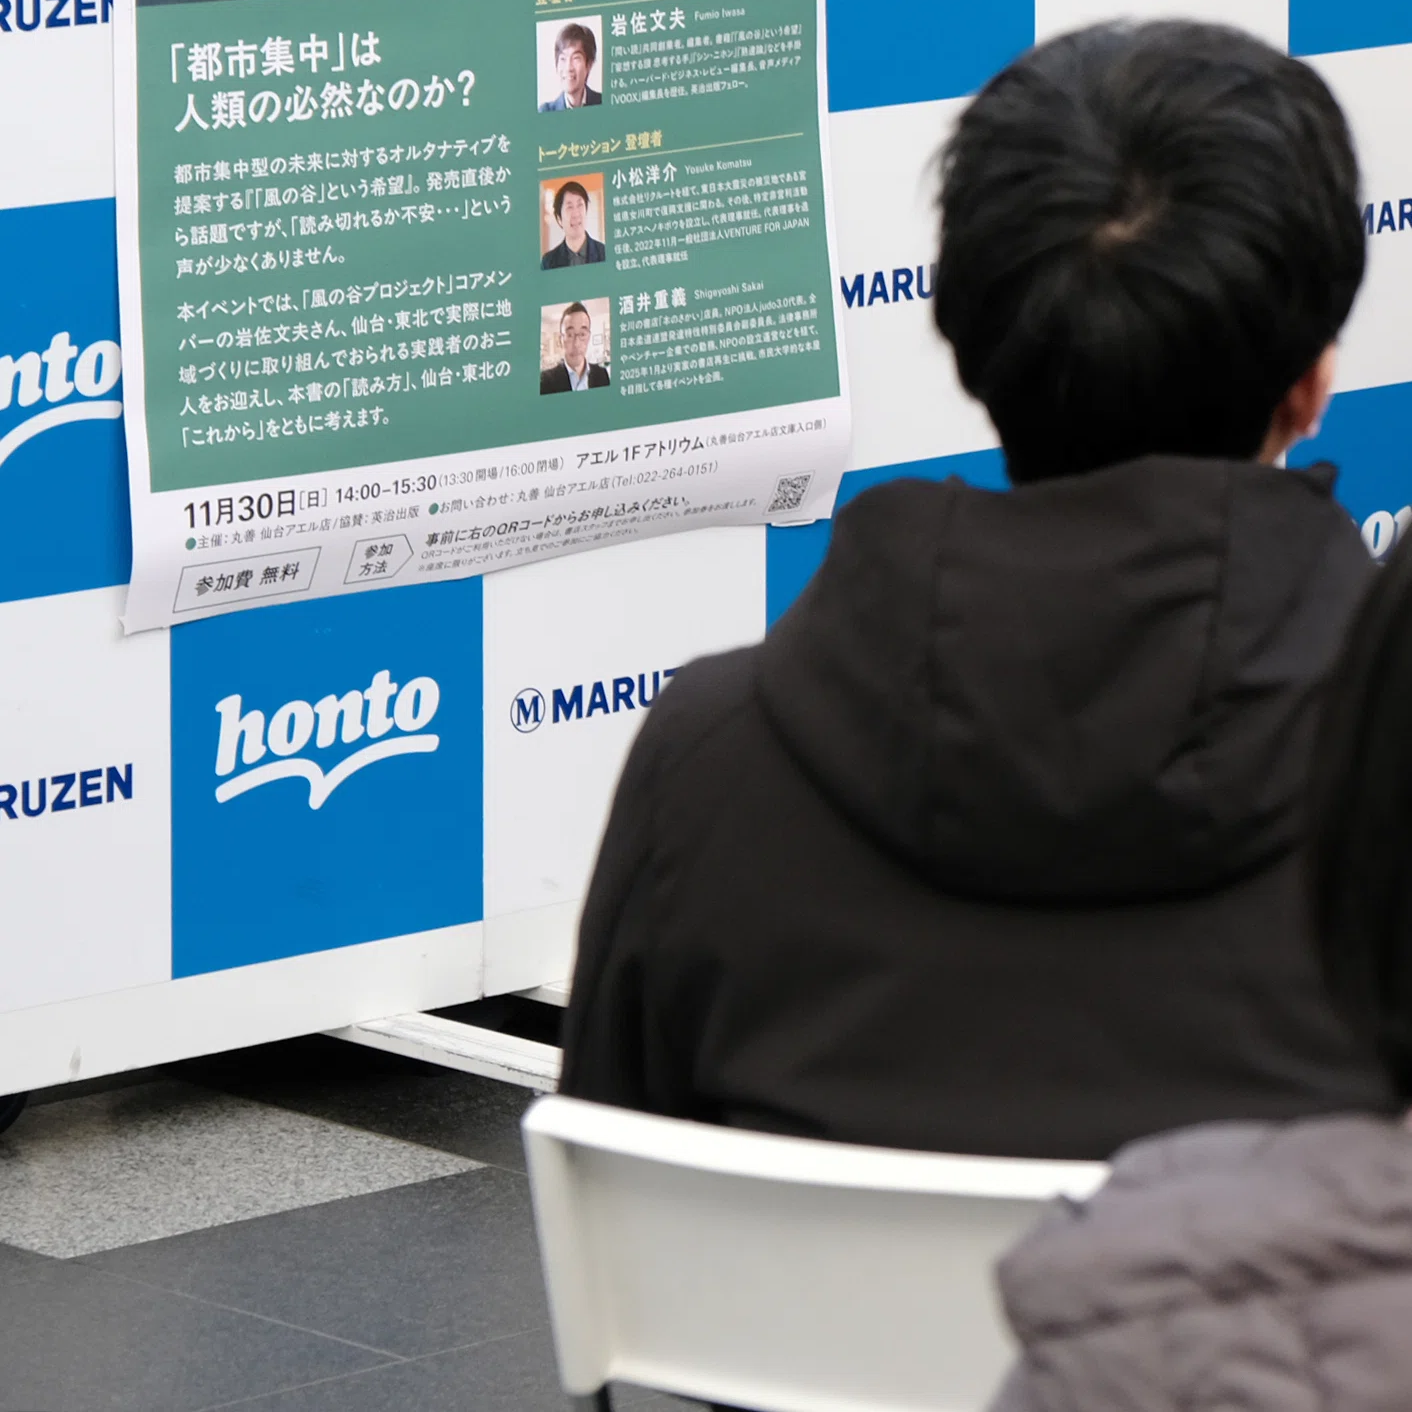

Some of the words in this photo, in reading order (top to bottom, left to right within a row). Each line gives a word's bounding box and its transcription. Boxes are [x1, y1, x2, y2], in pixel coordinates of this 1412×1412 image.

[611, 7, 686, 37] 岩佐文夫
[694, 10, 720, 22] Fumio
[721, 8, 746, 19] Iwasa
[171, 31, 382, 84] 「都市集中」は
[174, 70, 476, 133] 人類の必然なのか?
[173, 134, 512, 185] 都市集中型の未来に対するオルタナティブを
[538, 137, 621, 163] トークセッション
[625, 129, 663, 152] 登壇者
[612, 162, 678, 189] 小松洋介
[685, 163, 715, 176] Yosuke
[716, 158, 752, 172] Komatsu
[176, 245, 346, 279] 声が少なくありません。
[176, 270, 513, 322] 本イベントでは、「風の谷プロジェクト」コアメン
[618, 287, 687, 316] 酒井重義
[694, 283, 740, 300] Shigeyoshi
[741, 280, 764, 294] Sakai
[841, 264, 938, 310] MARU
[178, 299, 513, 352] バーの岩佐文夫さん、仙台・東北で実際に地
[0, 331, 122, 408] nto
[178, 330, 512, 385] 域づくりに取り組んでおられる実践者のお二
[181, 406, 390, 448] 「これから」をともに考えます。
[359, 559, 389, 577] 方法
[364, 543, 393, 559] 参加
[195, 570, 252, 596] 参加費
[258, 561, 300, 587] 無料
[552, 668, 687, 724] MARU
[215, 669, 440, 776] honto
[0, 763, 133, 820] RUZEN
